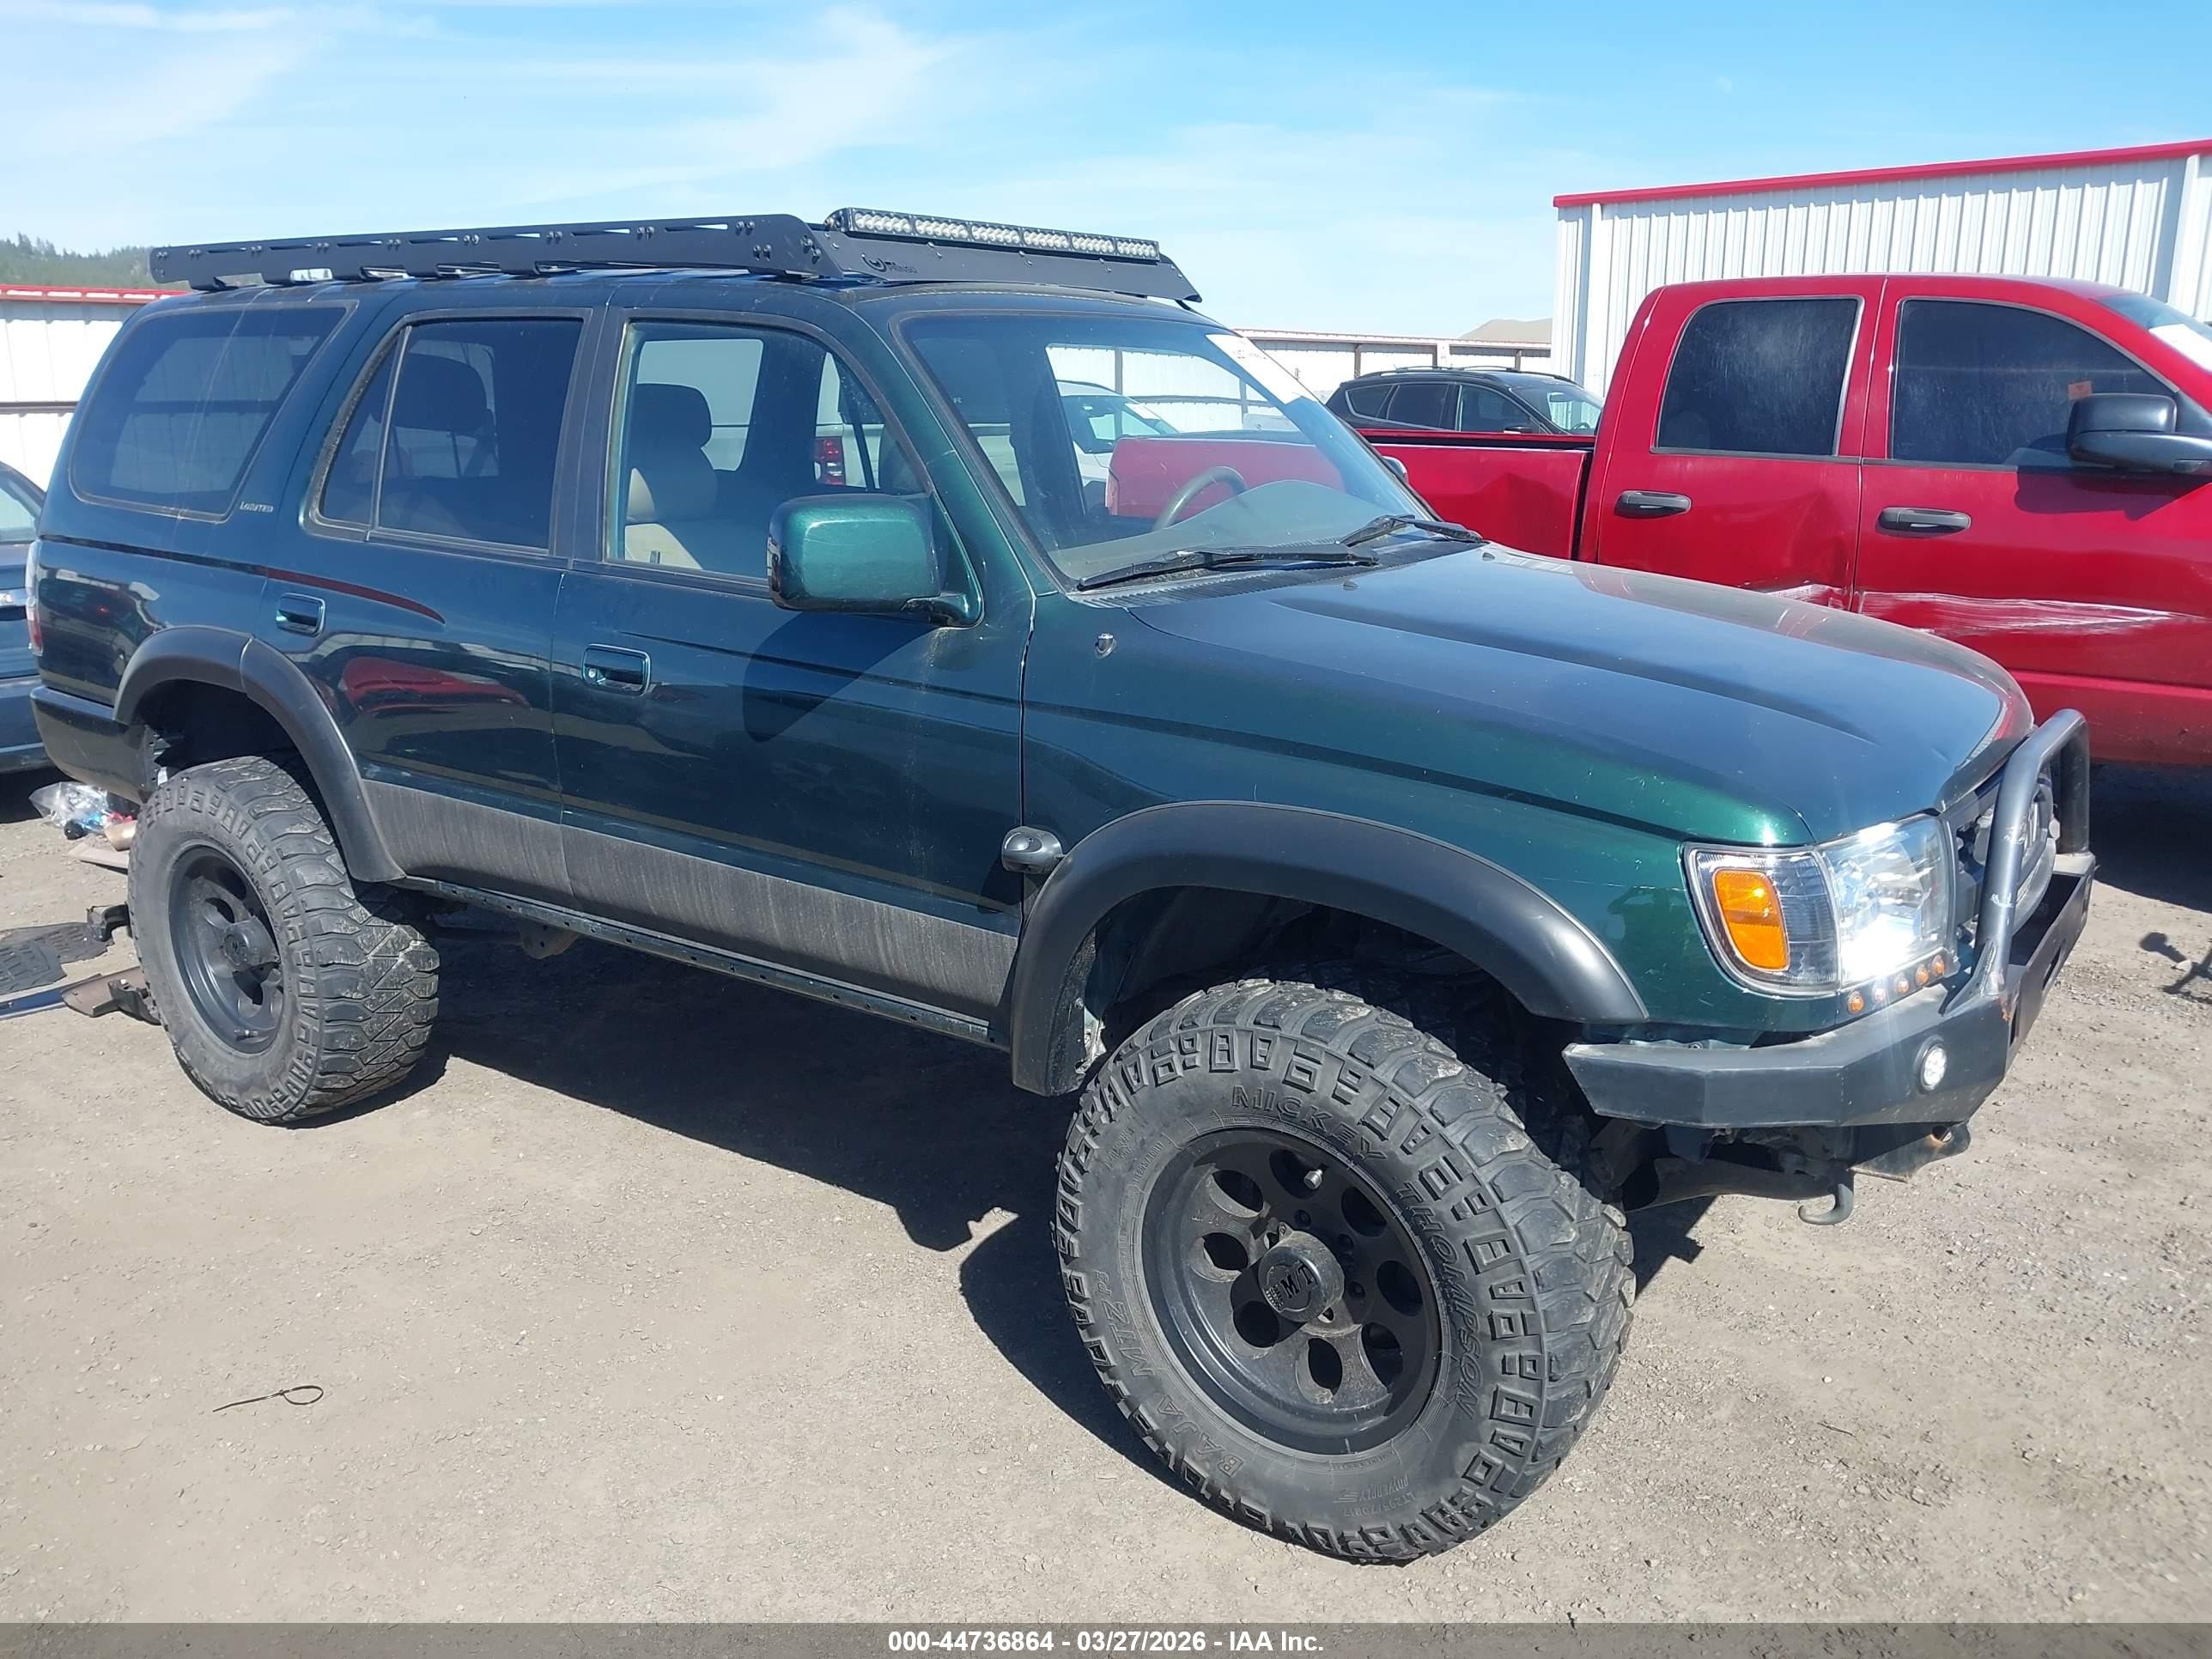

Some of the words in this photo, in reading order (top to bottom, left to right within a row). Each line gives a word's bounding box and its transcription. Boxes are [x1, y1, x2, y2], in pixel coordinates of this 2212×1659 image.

[1231, 1084, 1389, 1160] MICKEY
[1395, 1181, 1482, 1417] THOMPSON
[1102, 1298, 1154, 1378] MTZ
[1156, 1394, 1246, 1478] BAJA
